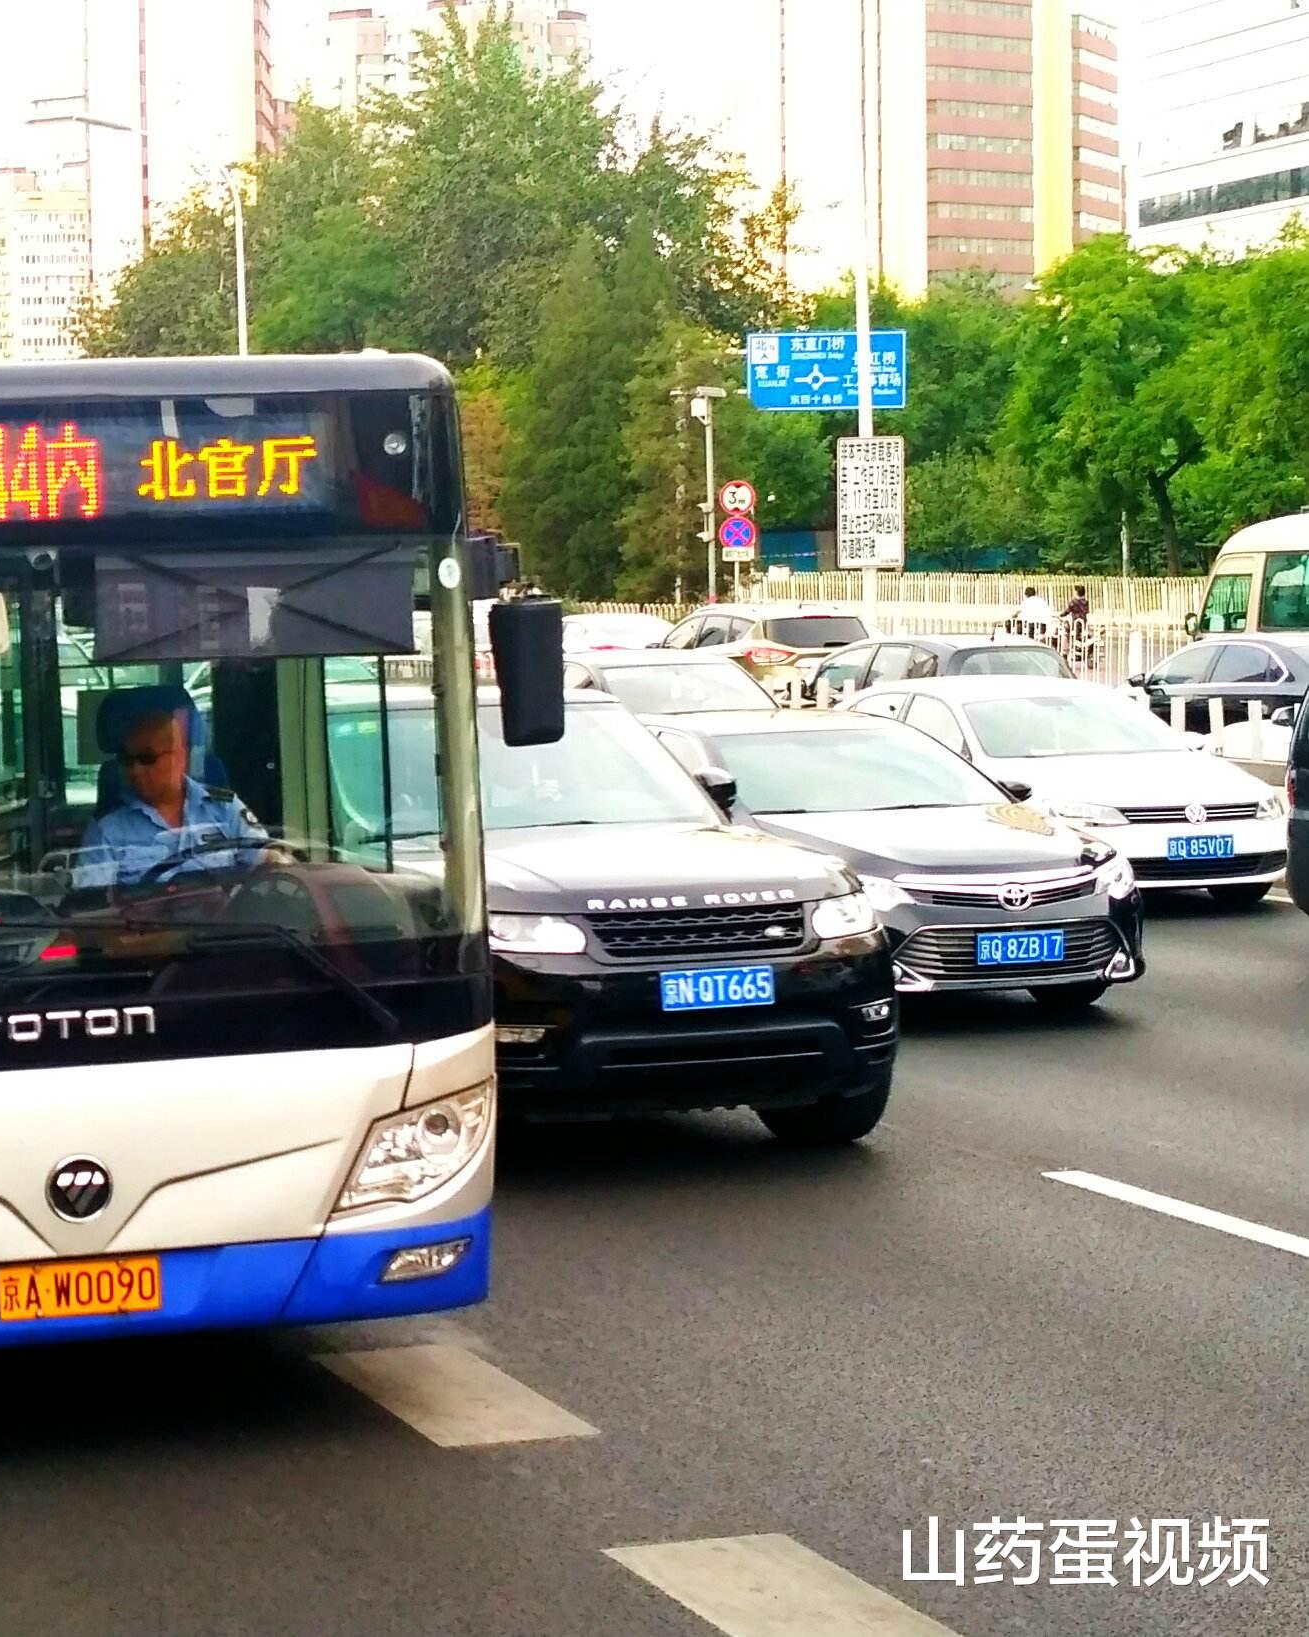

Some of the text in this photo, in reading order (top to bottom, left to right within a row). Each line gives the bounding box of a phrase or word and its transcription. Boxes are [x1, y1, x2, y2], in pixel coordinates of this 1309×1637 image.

[791, 337, 845, 351] 东直门桥
[136, 434, 319, 500] 北官厅
[586, 889, 795, 910] RANGE ROVER
